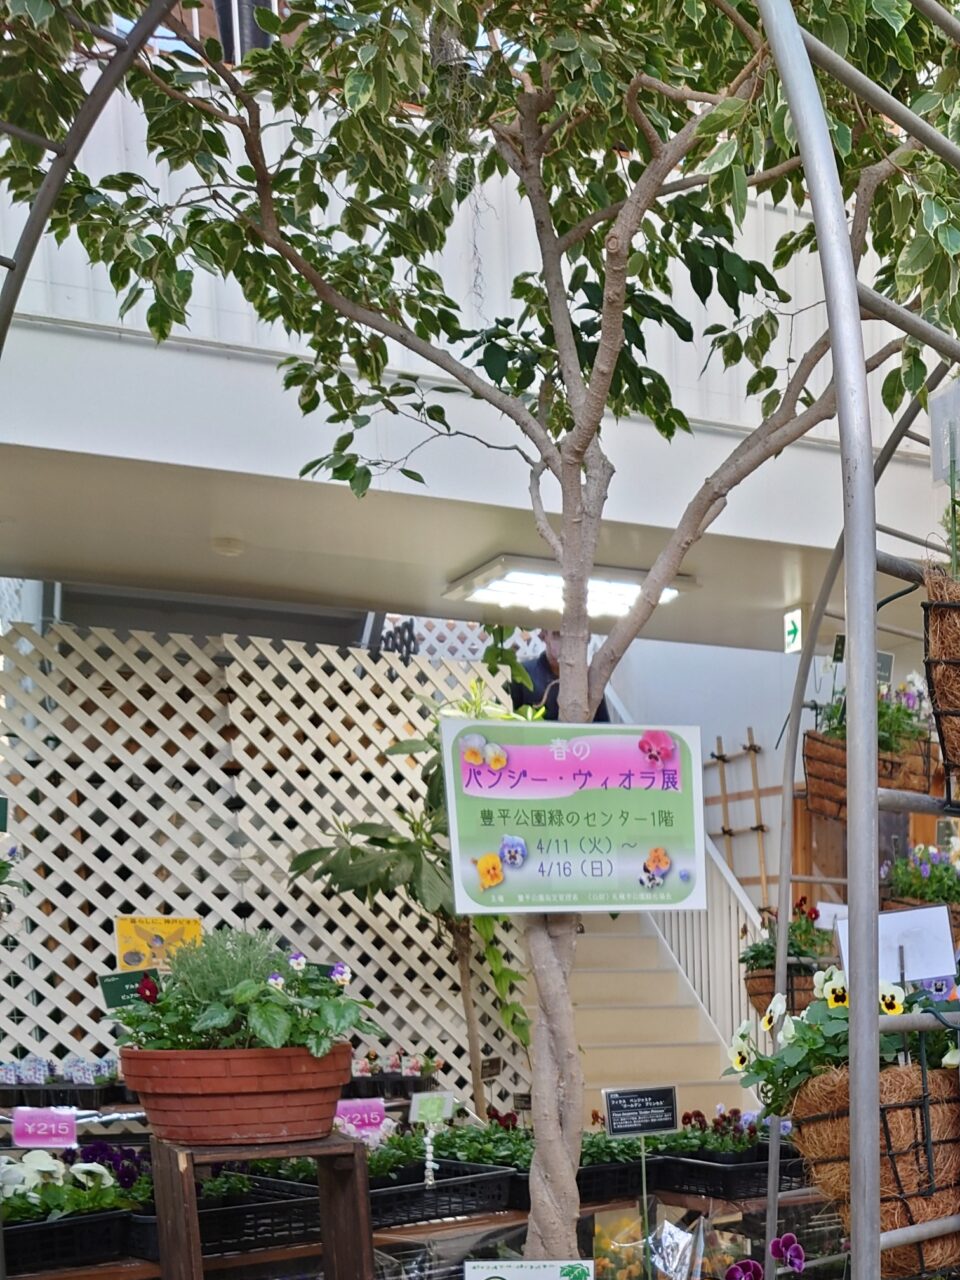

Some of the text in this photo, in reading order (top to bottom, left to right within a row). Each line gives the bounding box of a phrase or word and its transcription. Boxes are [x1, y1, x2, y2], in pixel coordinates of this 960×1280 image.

[549, 737, 591, 761] 春の
[464, 767, 680, 792] パンジー・ヴィオラ展
[479, 808, 675, 828] 豊平公園緑のセンター1階
[24, 1122, 69, 1135] ¥215
